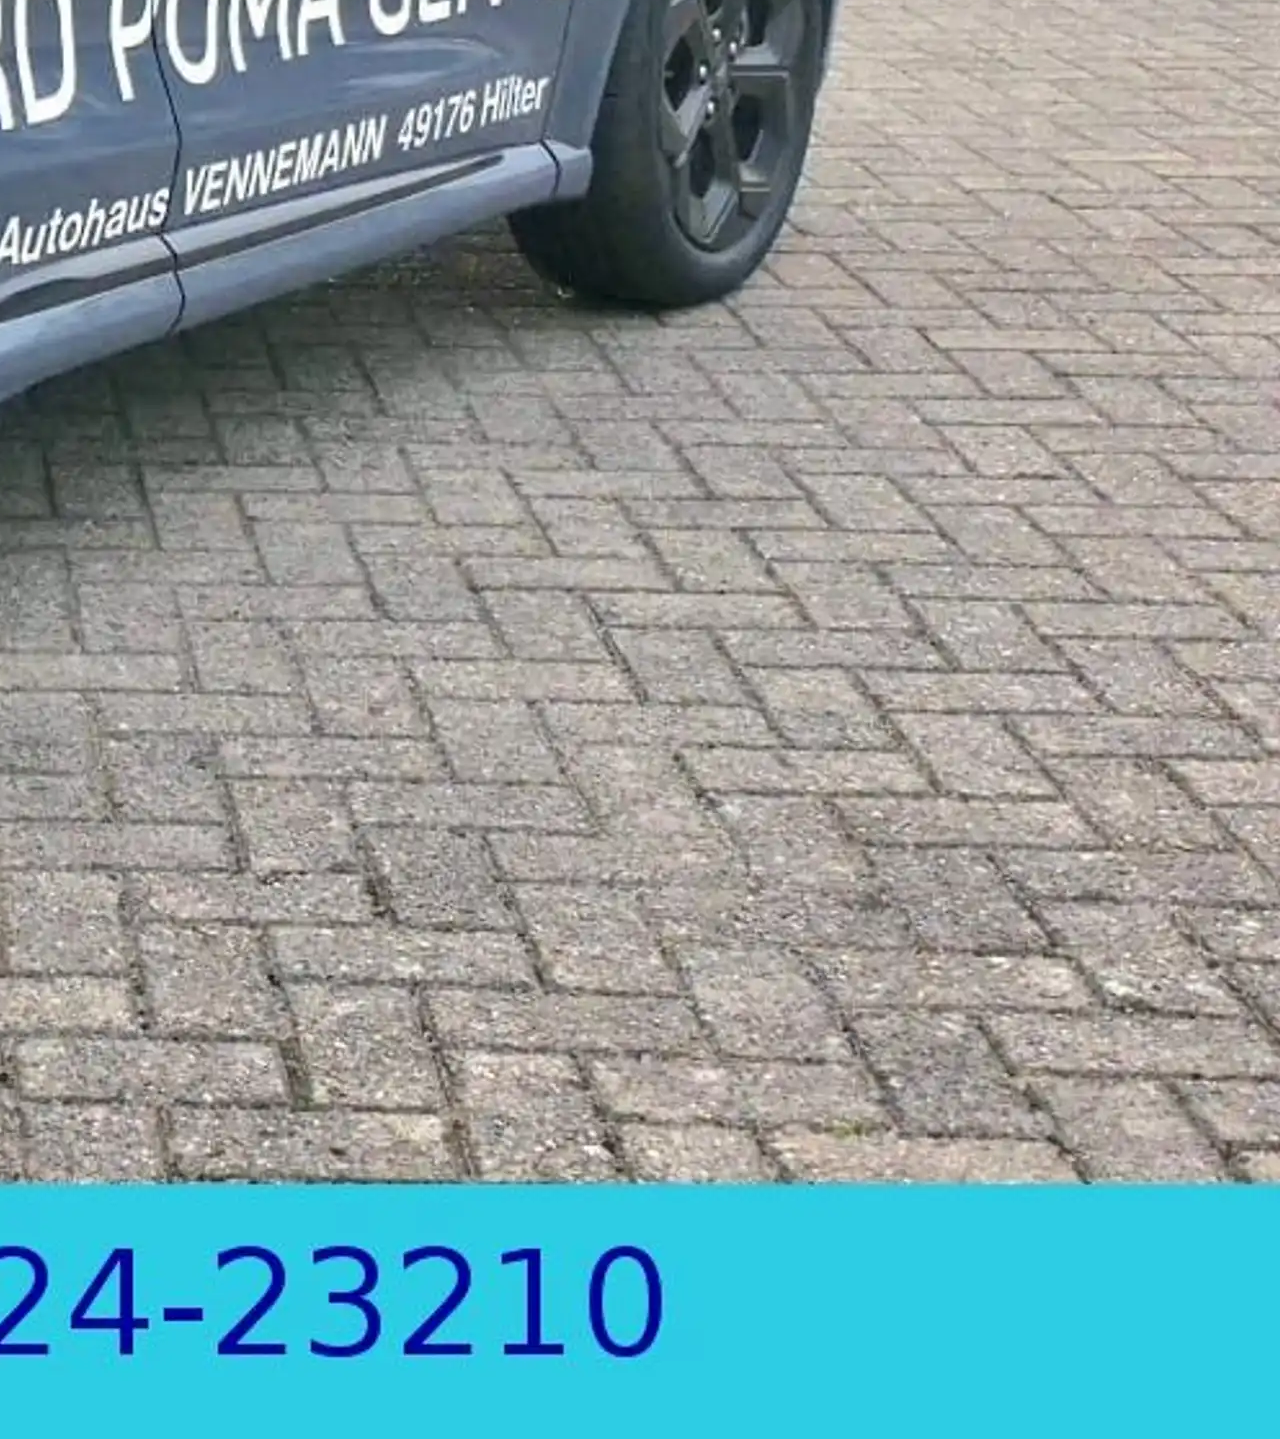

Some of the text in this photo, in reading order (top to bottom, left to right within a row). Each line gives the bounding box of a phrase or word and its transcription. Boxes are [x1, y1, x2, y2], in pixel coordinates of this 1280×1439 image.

[183, 115, 386, 216] VENNEMANN
[397, 99, 475, 152] 49176
[479, 76, 550, 129] Hilter
